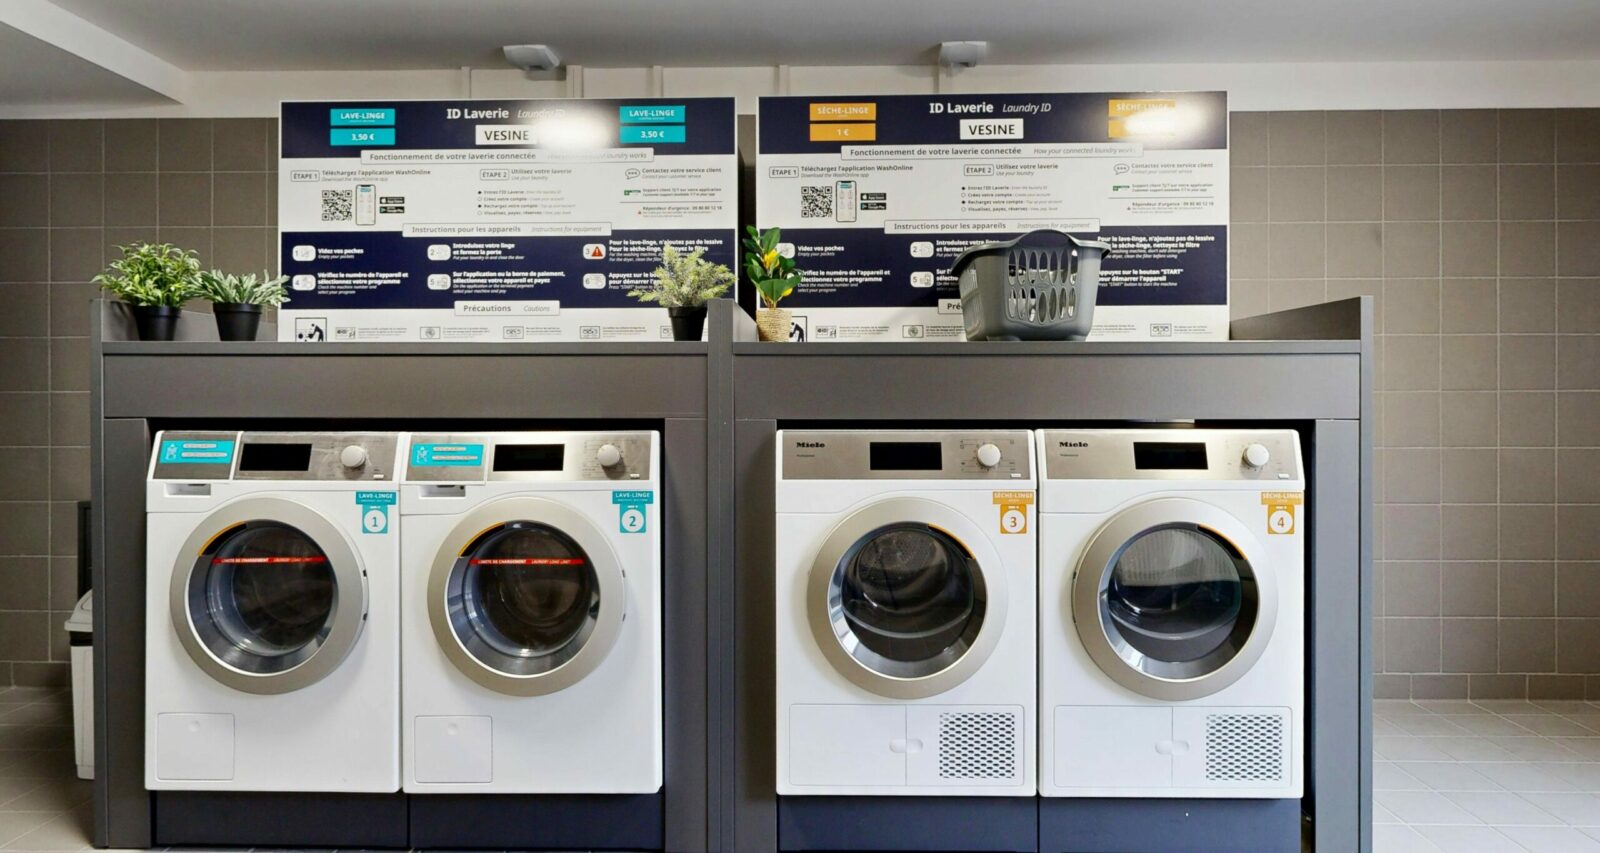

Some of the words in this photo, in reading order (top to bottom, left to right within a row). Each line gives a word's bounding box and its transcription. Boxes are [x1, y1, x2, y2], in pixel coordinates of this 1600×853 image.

[817, 105, 868, 114] SÈCHE-LINGE
[929, 102, 944, 113] ID
[947, 102, 994, 113] Laverie
[1002, 103, 1039, 115] Laundry
[1040, 102, 1052, 112] ID
[340, 112, 385, 120] LAVE-LINGE
[446, 108, 461, 119] ID
[464, 108, 509, 119] Laverie
[629, 109, 675, 117] LAVE-LINGE
[837, 128, 841, 136] 1
[842, 128, 849, 136] €
[968, 124, 1015, 135] VESINE
[369, 133, 375, 141] €
[484, 130, 529, 141] VESINE
[658, 130, 665, 139] €
[850, 148, 915, 156] Fonctionnement
[951, 147, 979, 155] laverie
[980, 147, 1022, 155] connectée
[1094, 147, 1117, 155] laundry
[370, 153, 433, 161] Fonctionnement
[468, 152, 495, 160] laverie
[496, 152, 537, 160] connectée
[772, 168, 792, 176] ÉTAPE
[801, 165, 837, 173] Téléchargez
[838, 164, 875, 173] l'application
[966, 166, 986, 174] ÉTAPE
[293, 172, 313, 180] ÉTAPE
[488, 225, 521, 234] appareils
[894, 222, 939, 230] Instructions
[940, 223, 958, 231] pour
[959, 221, 970, 229] les
[971, 221, 1006, 230] appareils
[1119, 242, 1152, 250] sèche-linge,
[1153, 242, 1178, 250] nettoyez
[344, 248, 364, 256] poches
[503, 277, 527, 285] appareil
[1139, 275, 1167, 283] l'appareil
[463, 304, 512, 312] Précautions
[523, 304, 551, 312] Cautions
[371, 516, 378, 528] 1
[629, 516, 636, 527] 2
[1009, 516, 1017, 528] 3
[1277, 516, 1285, 528] 4
